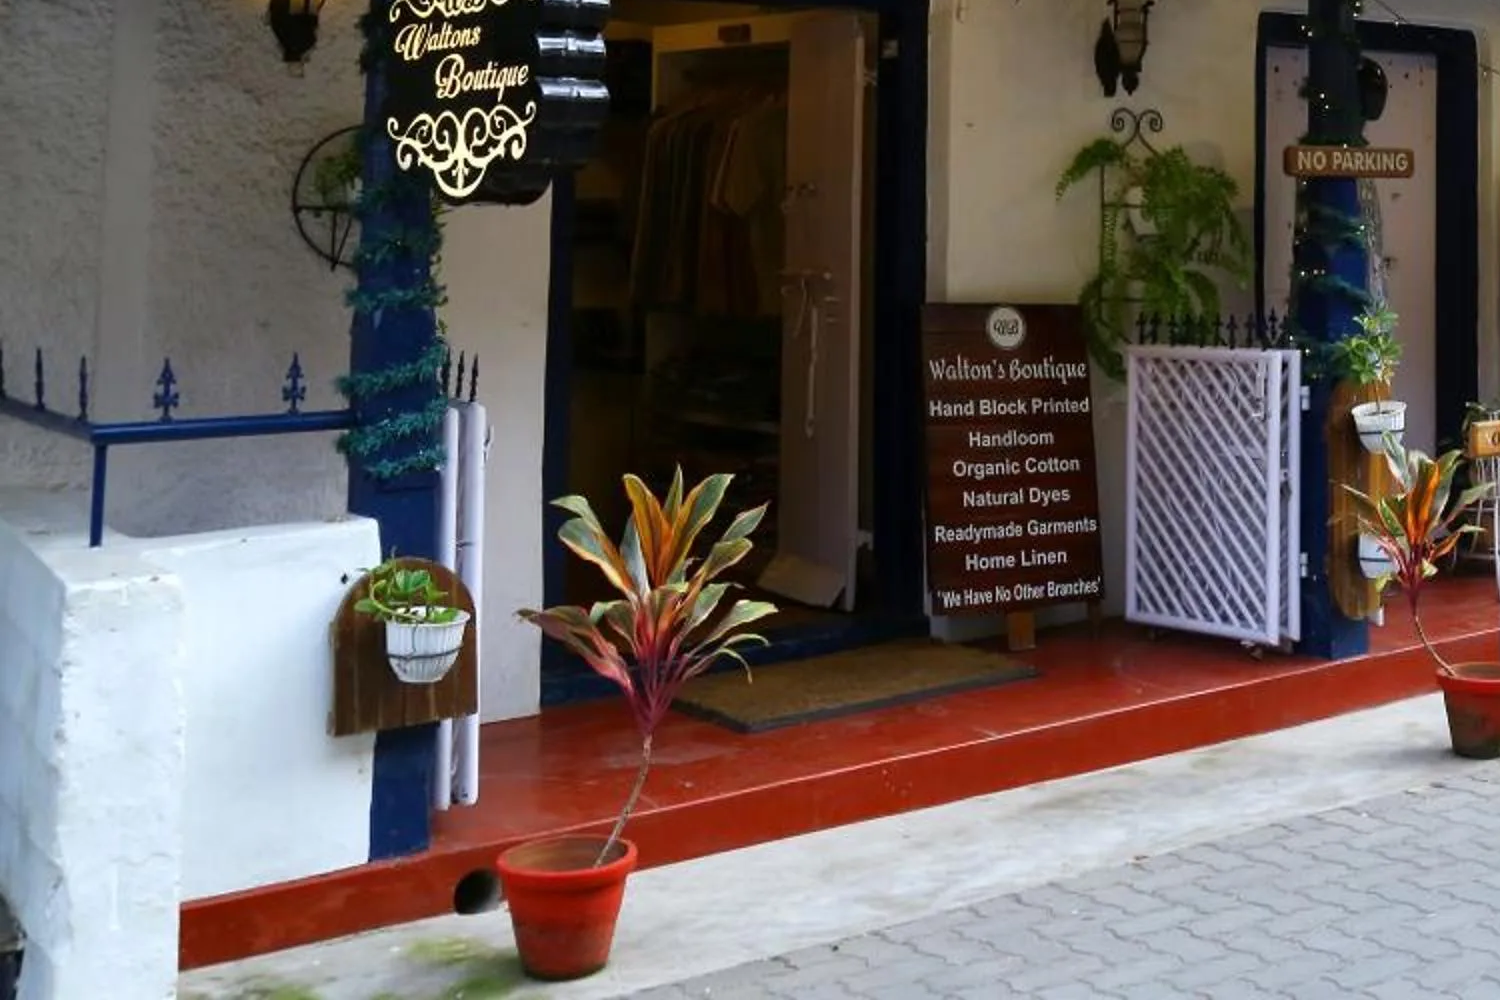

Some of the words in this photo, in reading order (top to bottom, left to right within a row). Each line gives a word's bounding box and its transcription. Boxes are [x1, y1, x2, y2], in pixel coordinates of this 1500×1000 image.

[394, 21, 482, 62] Waltons
[435, 53, 529, 102] Boutique
[1298, 150, 1327, 171] NO
[1332, 150, 1409, 172] PARKING
[929, 353, 1006, 382] Walton's
[1009, 354, 1088, 385] Boutique
[929, 399, 975, 417] Hand
[979, 398, 1028, 415] Block
[1031, 397, 1090, 414] Printed
[968, 430, 1055, 448] Handloom
[953, 459, 1020, 480] Organic
[1025, 456, 1080, 474] Cotton
[963, 488, 1024, 508] Natural
[1029, 487, 1071, 507] Dyes
[935, 521, 1023, 544] Readymade
[1027, 517, 1097, 536] Garments
[965, 553, 1016, 571] Home
[1021, 550, 1068, 567] Linen
[964, 589, 993, 605] Have
[995, 585, 1011, 602] No
[1013, 583, 1045, 600] Other
